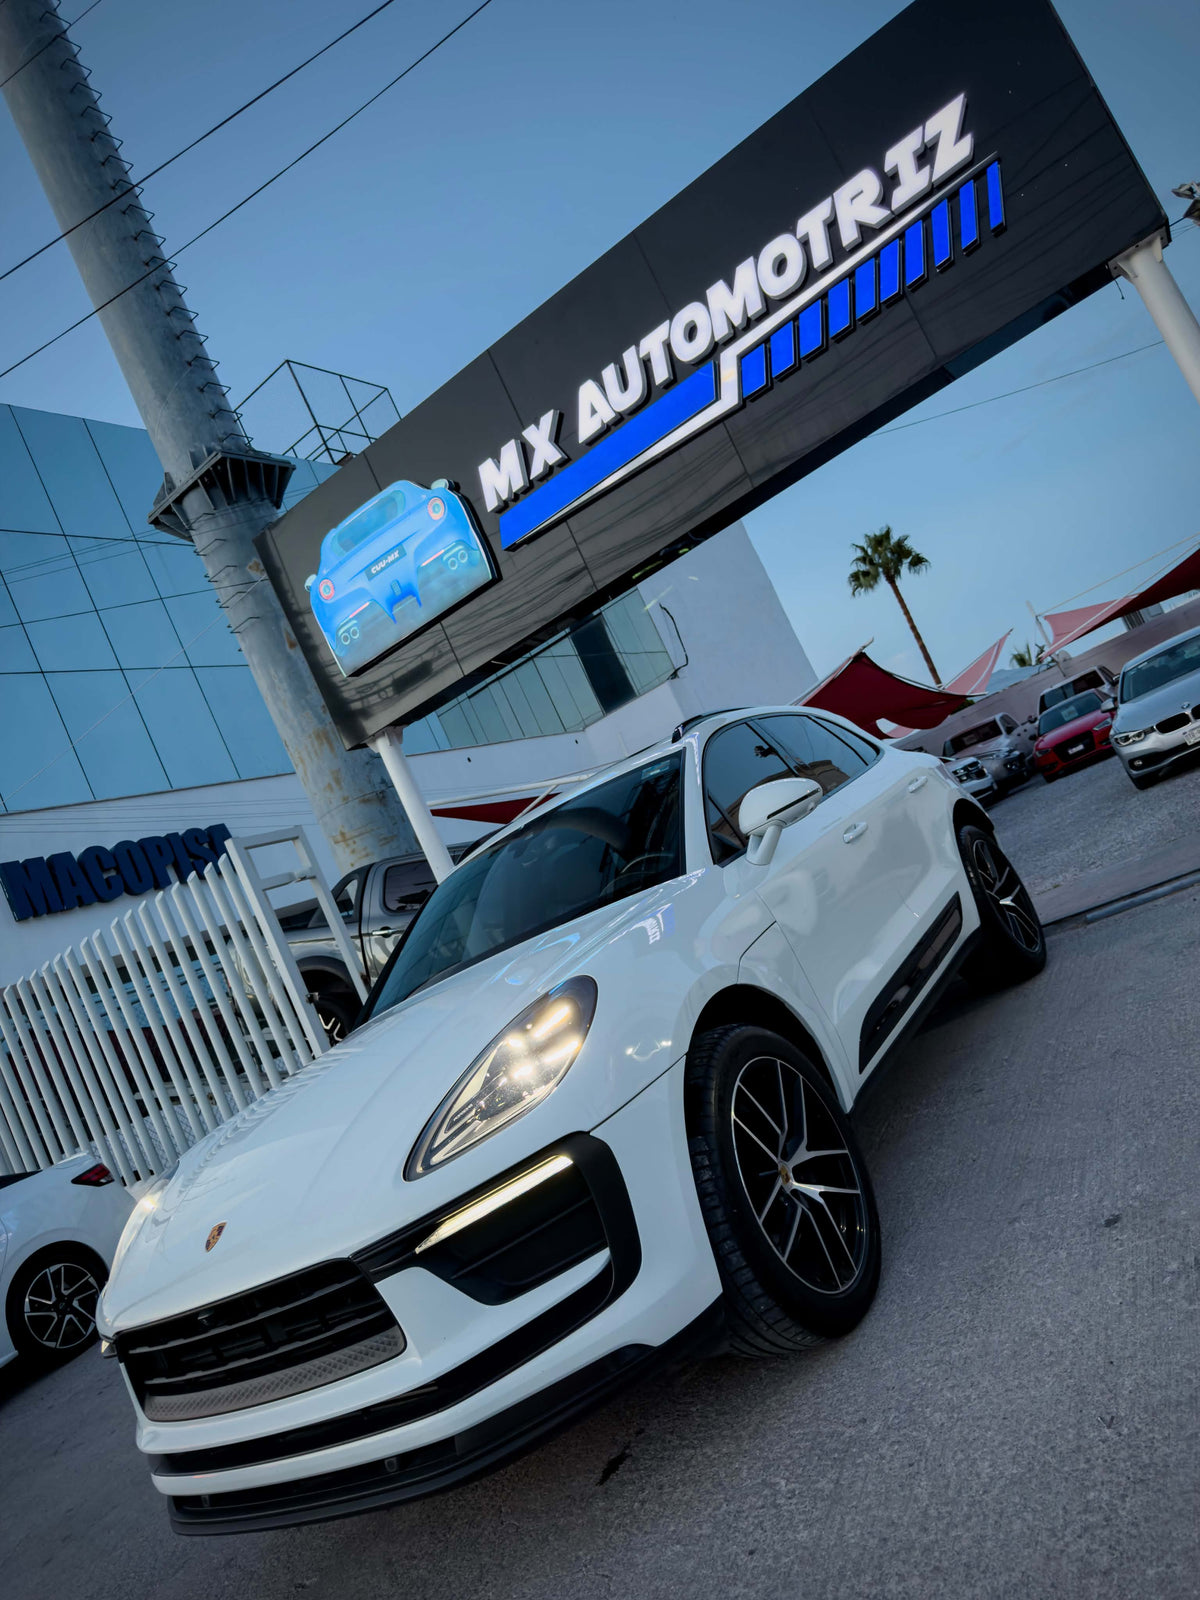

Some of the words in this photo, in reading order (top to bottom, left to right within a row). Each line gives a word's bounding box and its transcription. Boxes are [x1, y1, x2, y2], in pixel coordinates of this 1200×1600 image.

[478, 408, 565, 513] MX
[578, 92, 973, 444] AUTOMOTRIZ
[370, 549, 400, 575] CUU-MX
